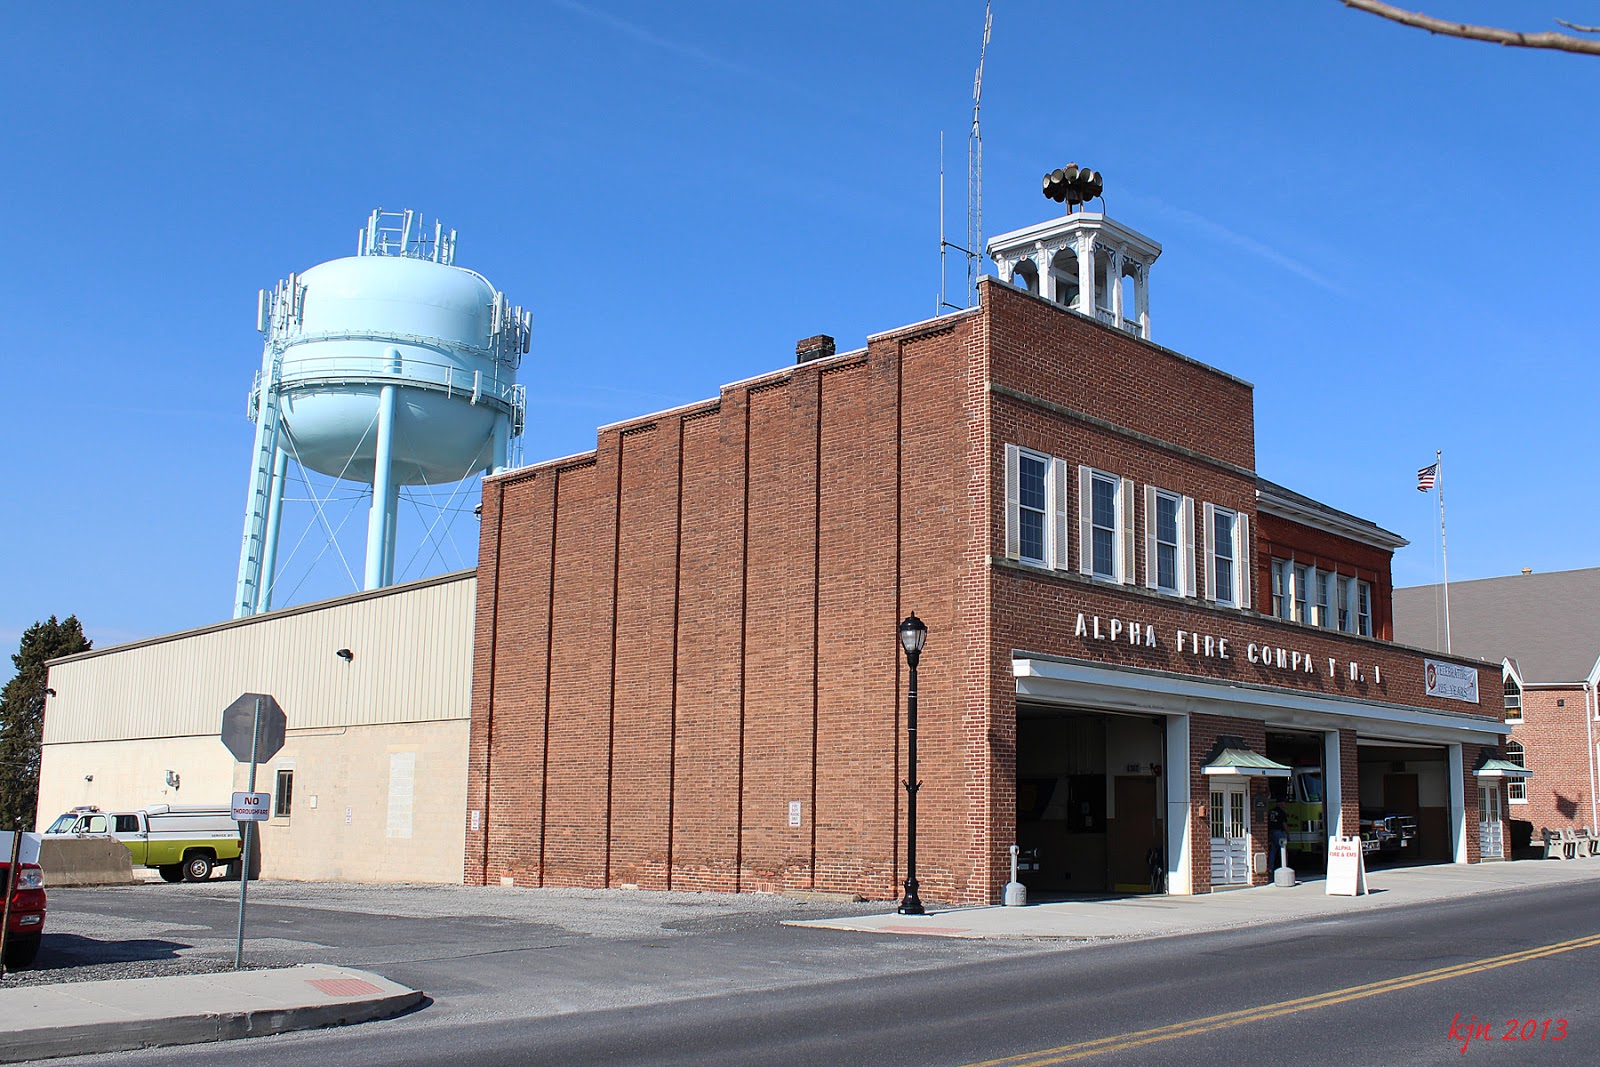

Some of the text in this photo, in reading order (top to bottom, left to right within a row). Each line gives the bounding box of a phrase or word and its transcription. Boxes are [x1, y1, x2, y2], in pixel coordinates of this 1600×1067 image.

[1074, 612, 1157, 648] ALPHA
[1176, 629, 1229, 660] FIRE
[244, 796, 260, 805] NO
